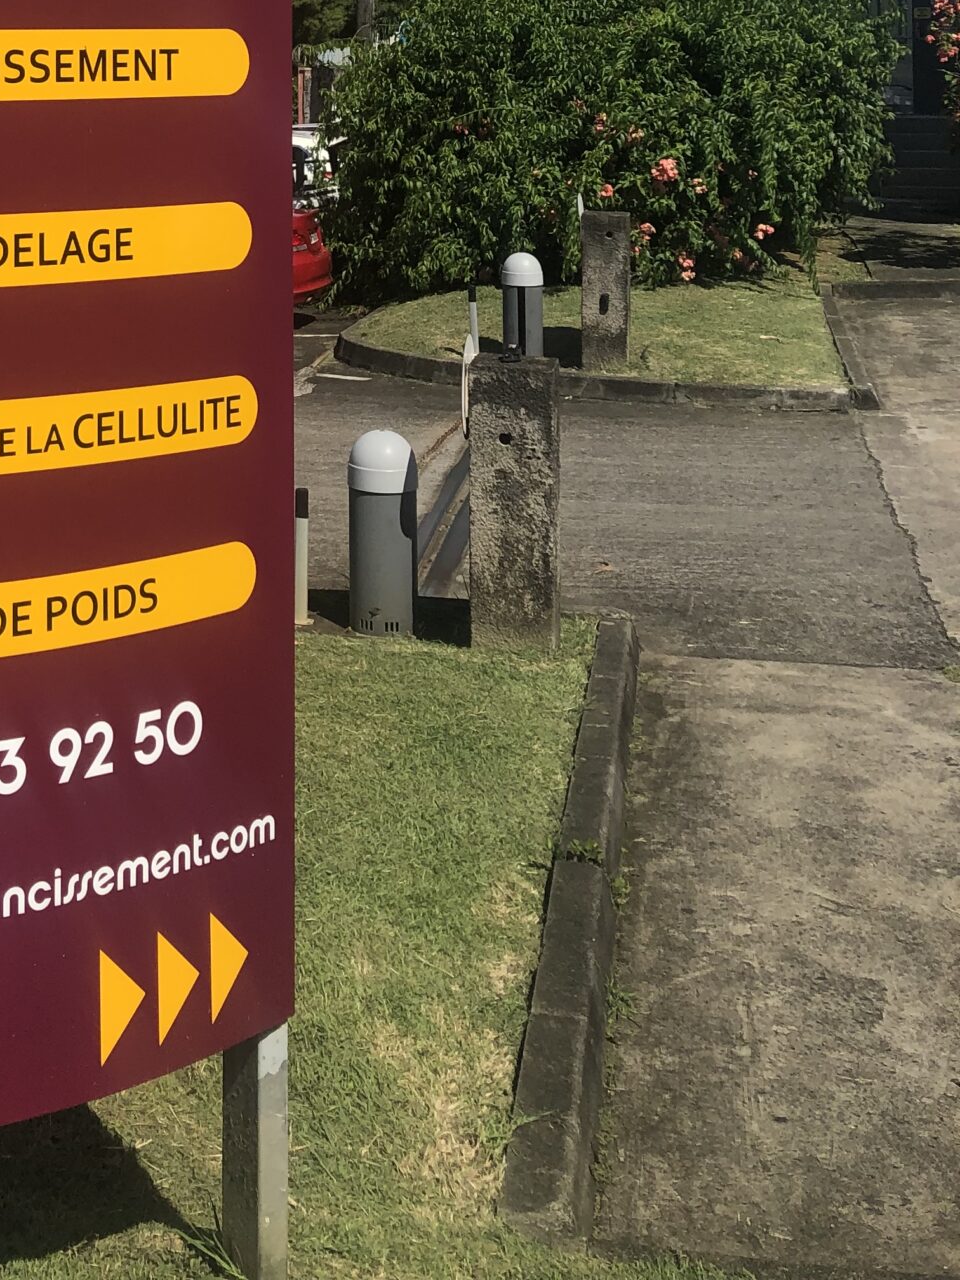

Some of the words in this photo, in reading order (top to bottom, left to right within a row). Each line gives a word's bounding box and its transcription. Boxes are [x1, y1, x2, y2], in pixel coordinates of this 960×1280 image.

[26, 423, 65, 454] LA
[73, 394, 241, 450] CELLULITE
[46, 578, 159, 632] POIDS
[49, 720, 114, 784] 92
[133, 700, 203, 765] 50
